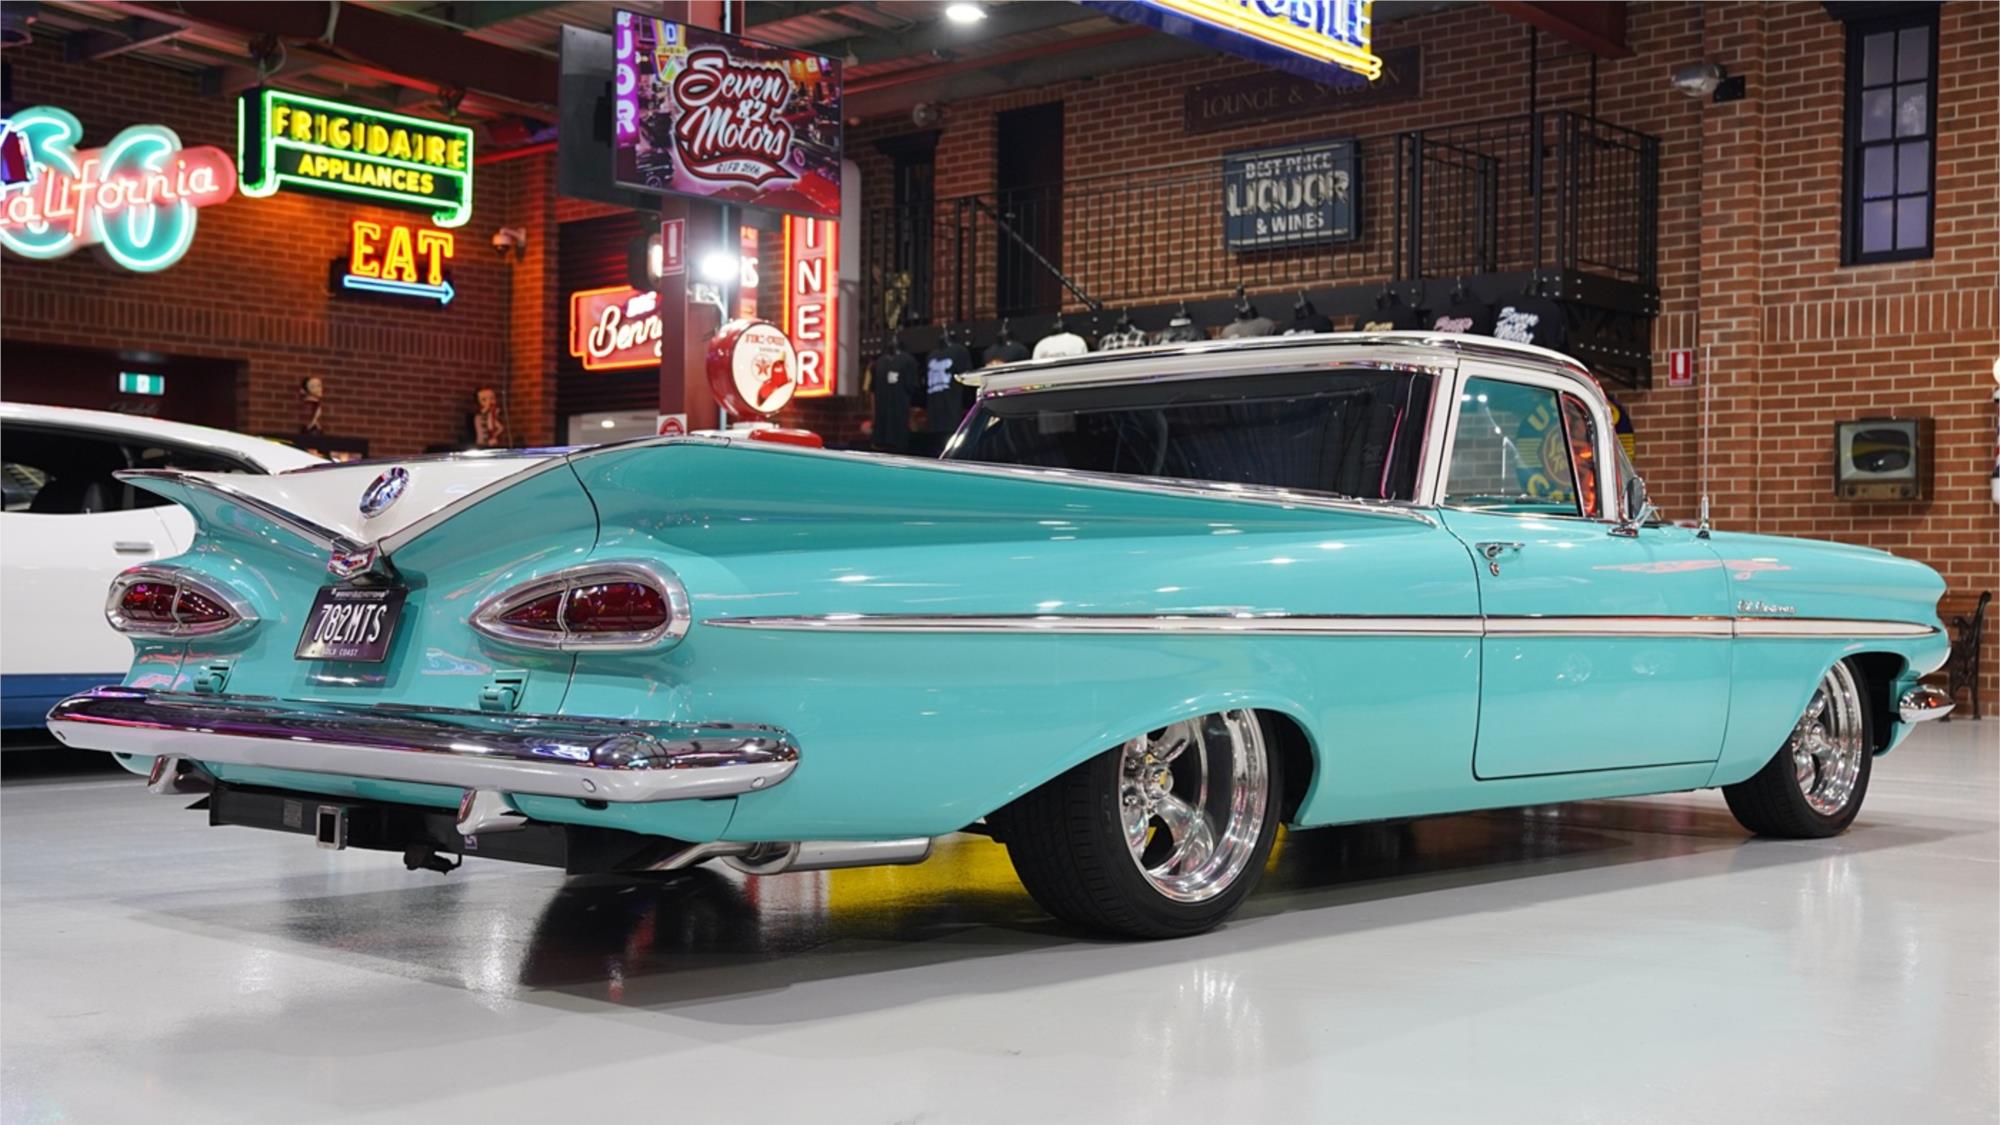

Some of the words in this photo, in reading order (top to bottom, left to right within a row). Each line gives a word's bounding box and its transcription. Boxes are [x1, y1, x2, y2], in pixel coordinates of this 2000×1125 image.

[679, 58, 784, 107] Seven
[1203, 87, 1281, 119] LOUNGE
[1289, 86, 1304, 104] &
[681, 106, 786, 156] Motors
[736, 99, 767, 122] 82
[272, 106, 466, 169] FRIGIDAIRE
[298, 153, 434, 194] APPLIANCES
[1245, 158, 1283, 179] BEST
[1285, 152, 1333, 174] PRICE
[0, 159, 220, 237] alifornia
[1227, 170, 1349, 217] LIQUOR
[1256, 217, 1268, 236] &
[1271, 211, 1325, 233] WINES
[352, 220, 454, 286] EAT
[312, 603, 388, 643] 782MTS
[339, 648, 358, 656] COAST
